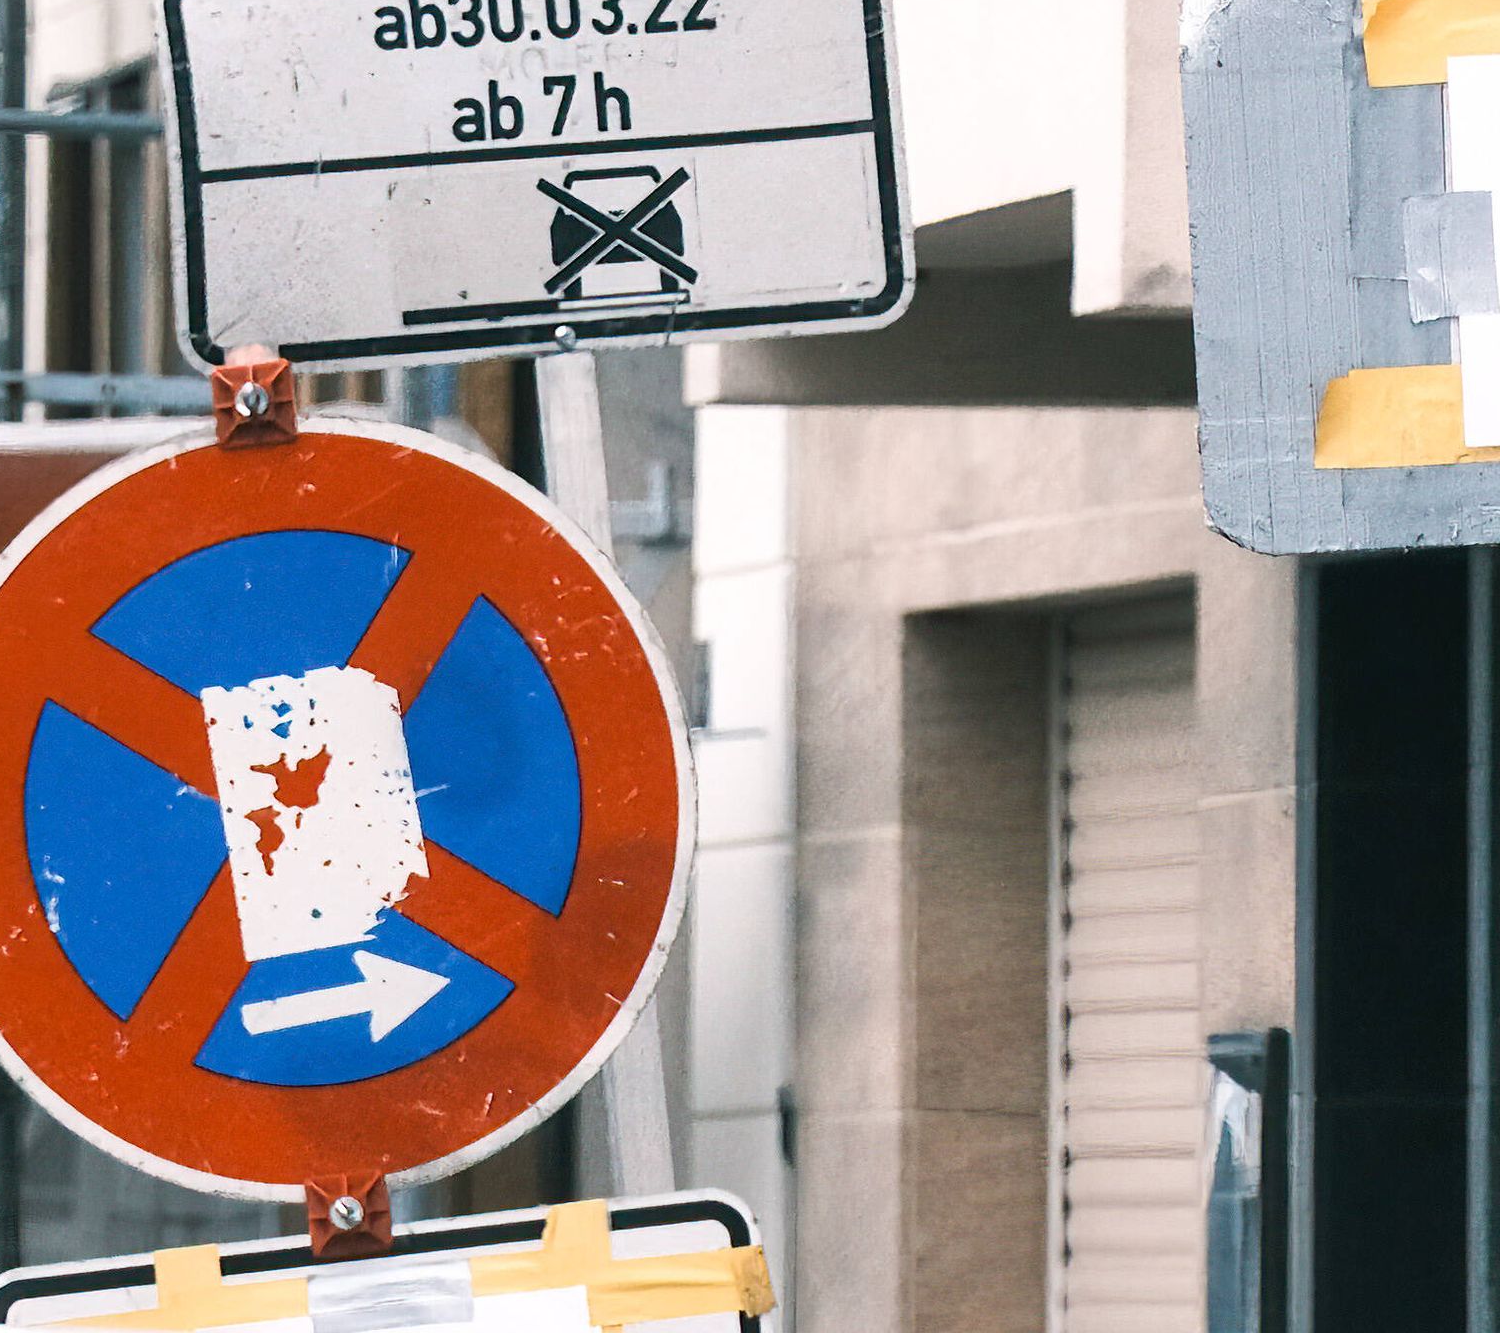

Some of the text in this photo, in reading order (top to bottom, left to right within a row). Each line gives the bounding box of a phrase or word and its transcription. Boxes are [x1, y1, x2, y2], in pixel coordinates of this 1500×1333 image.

[452, 71, 632, 142] ab 7 h
